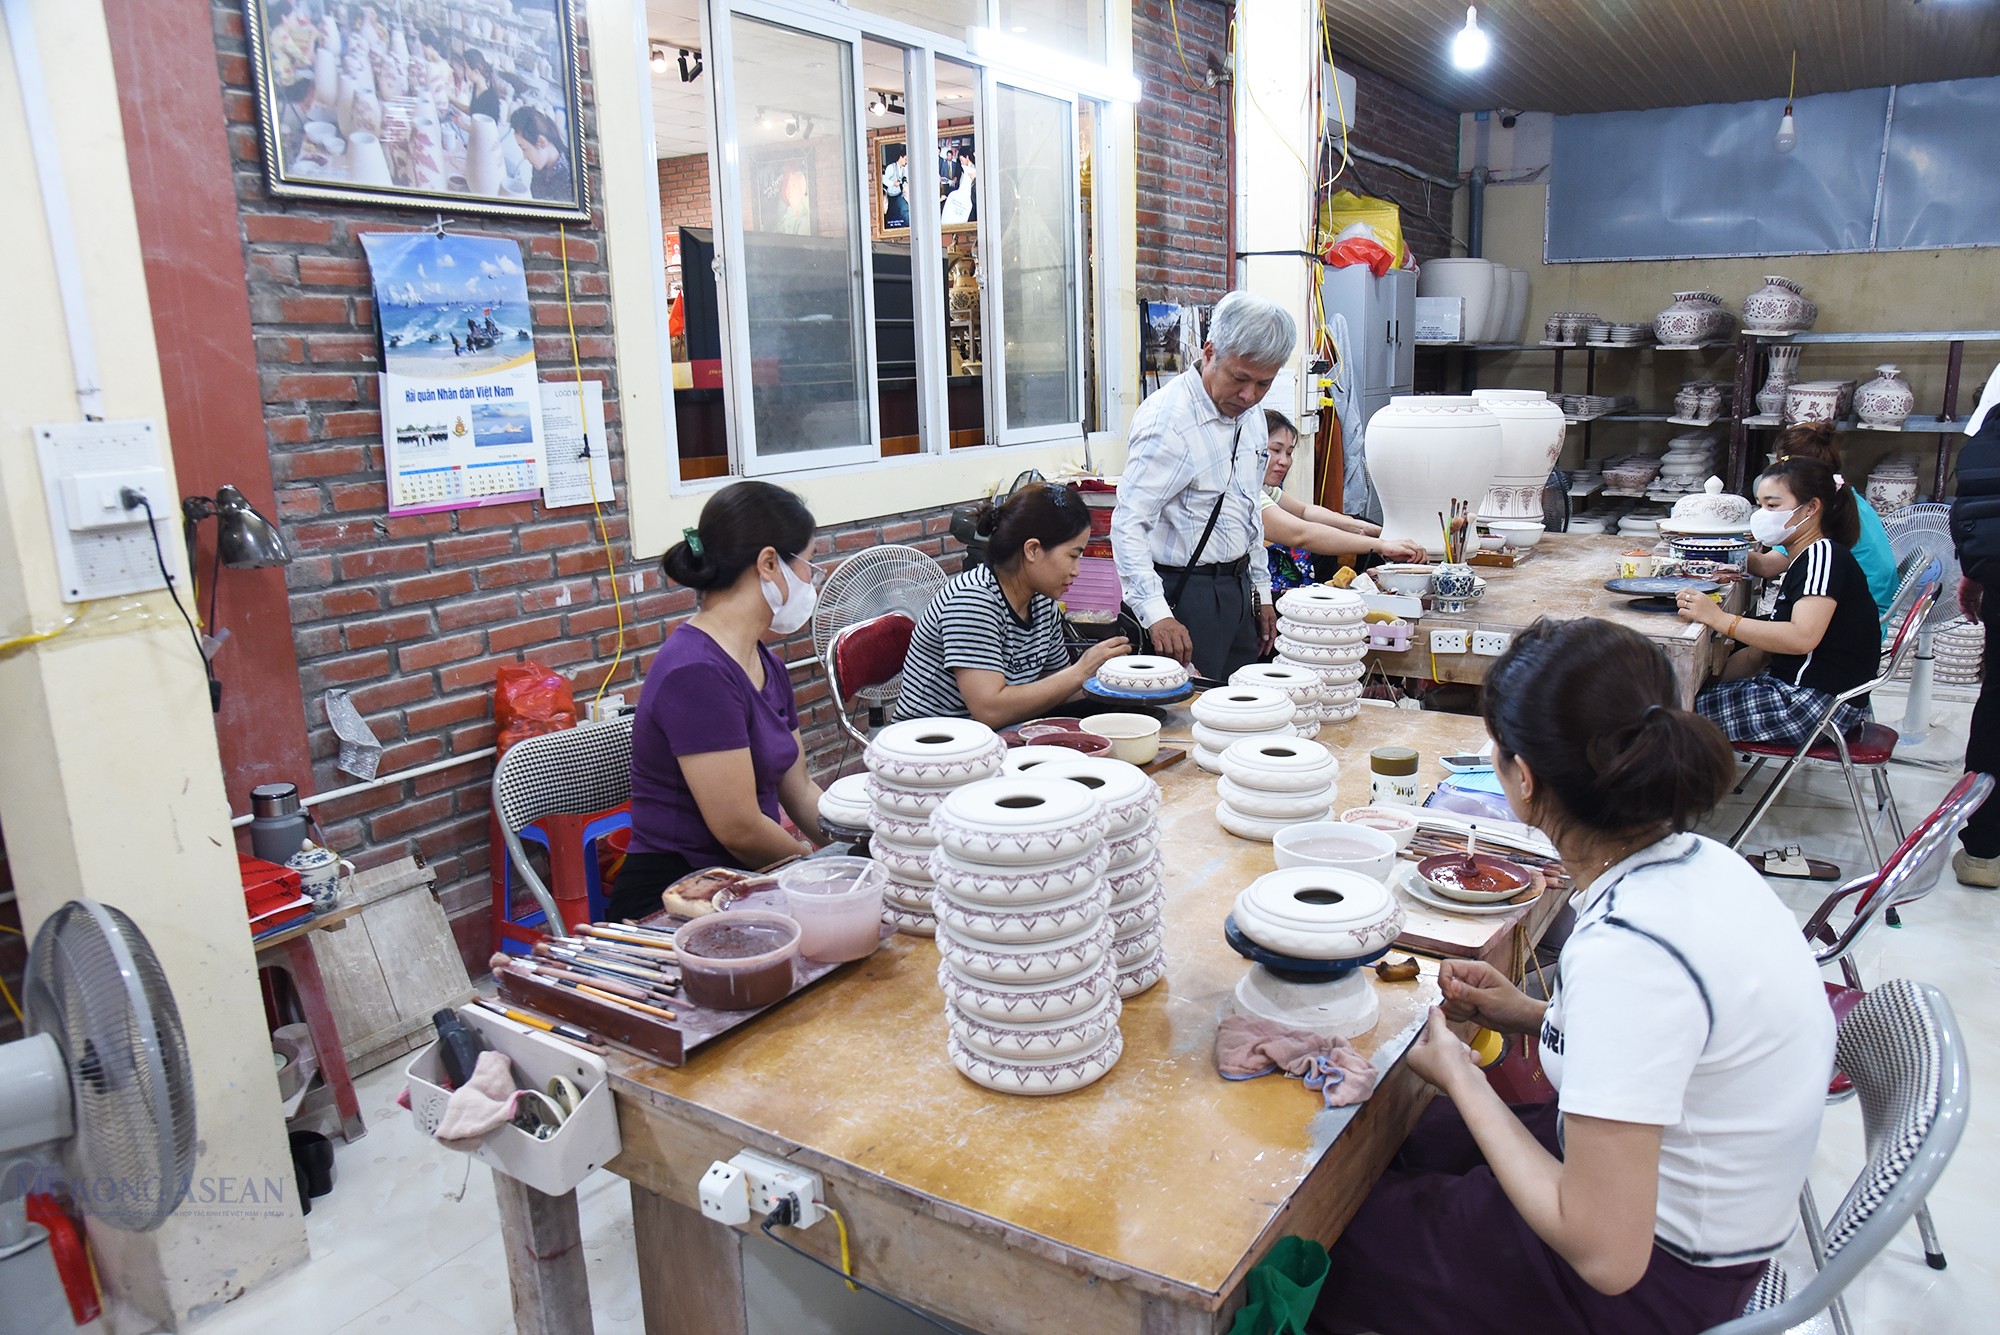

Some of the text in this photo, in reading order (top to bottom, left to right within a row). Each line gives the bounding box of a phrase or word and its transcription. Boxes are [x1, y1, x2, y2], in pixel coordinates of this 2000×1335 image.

[417, 389, 436, 403] quân
[437, 388, 458, 401] Nhân
[460, 387, 475, 399] dân
[476, 386, 492, 400] Việt
[493, 385, 514, 398] Nam
